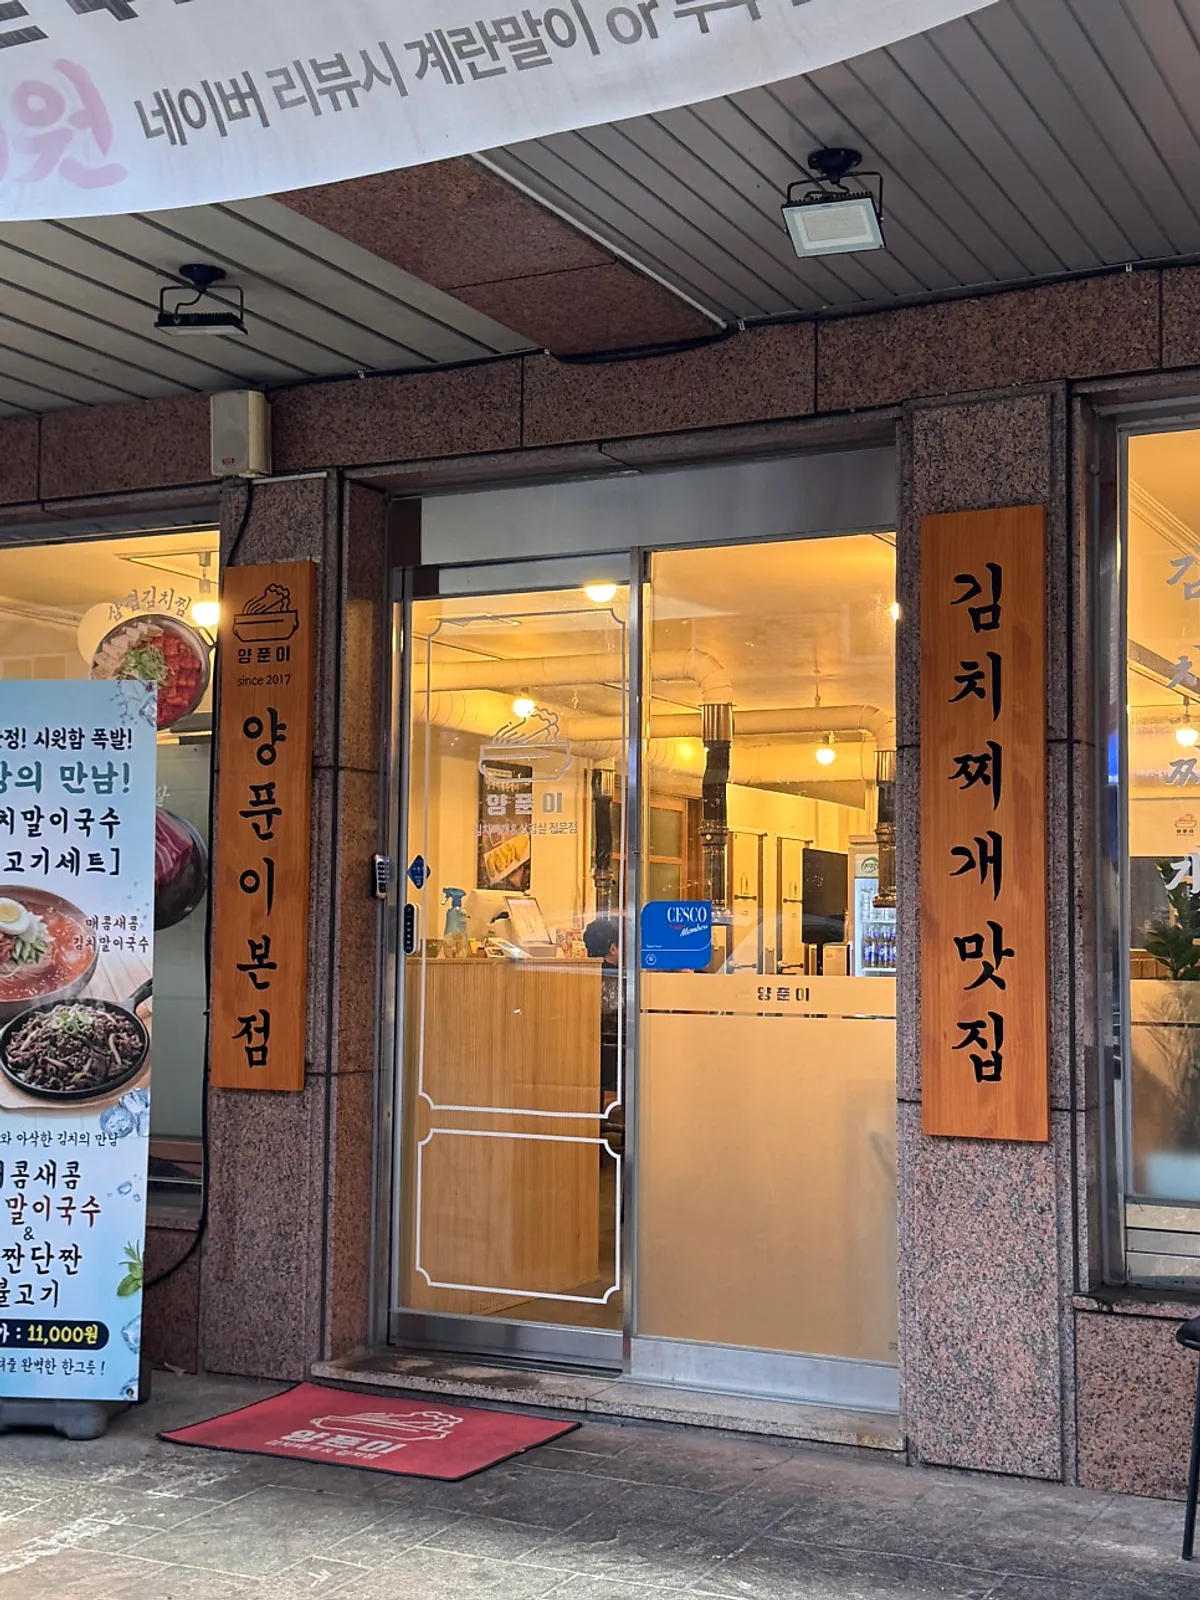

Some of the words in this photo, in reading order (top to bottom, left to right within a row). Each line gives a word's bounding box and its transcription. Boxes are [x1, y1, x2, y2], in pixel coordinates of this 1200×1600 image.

[134, 71, 271, 147] 네이버
[265, 40, 409, 117] 리뷰시
[403, 0, 601, 86] 계란말이
[606, 3, 661, 46] or
[0, 58, 128, 190] 원
[237, 645, 291, 664] 양푼이
[237, 674, 264, 687] since
[266, 673, 292, 686] 2017
[0, 726, 26, 750] 정!
[33, 726, 85, 751] 시원함
[91, 727, 133, 750] 폭발!
[59, 760, 131, 794] 만남!
[486, 791, 563, 817] 양푼이
[948, 562, 1015, 1084] 김치찌개맛집
[231, 706, 287, 1069] 양푼이본점
[85, 914, 140, 932] 매콤새콤
[667, 906, 707, 923] CESCO
[73, 935, 150, 954] 김치말이국수
[757, 985, 810, 1002] 양푼이
[16, 1130, 53, 1147] 아삭한
[57, 1131, 90, 1147] 김치의
[96, 1131, 119, 1147] 만남
[5, 1192, 102, 1228] 말이국수
[23, 1226, 35, 1241] &
[1, 1240, 83, 1275] 짠단짠
[27, 1323, 99, 1346] 11,000원
[20, 1356, 57, 1375] 완벽한
